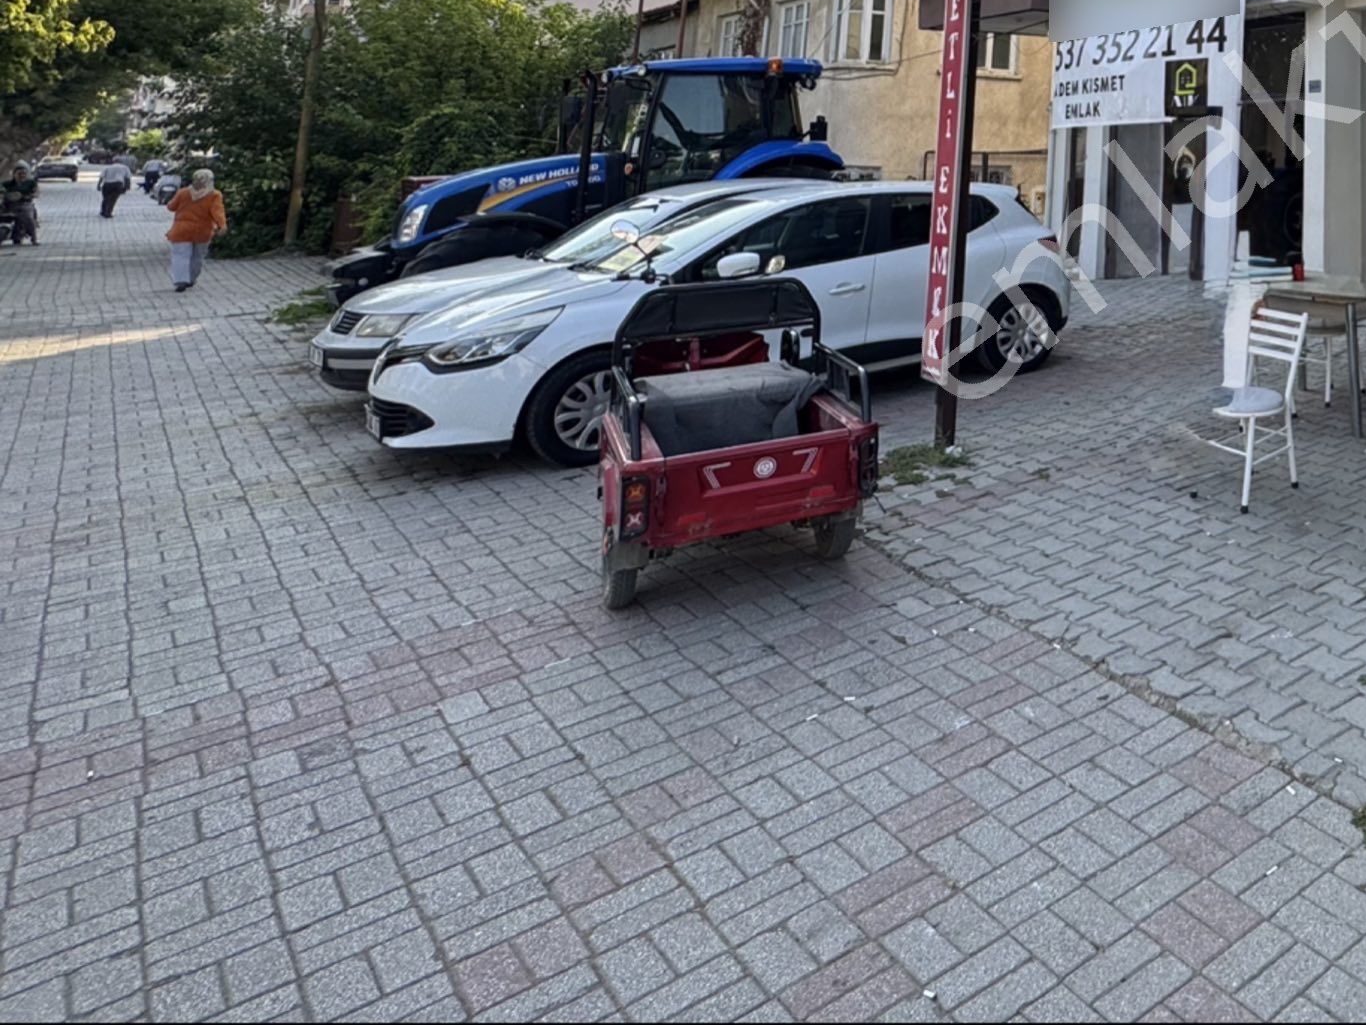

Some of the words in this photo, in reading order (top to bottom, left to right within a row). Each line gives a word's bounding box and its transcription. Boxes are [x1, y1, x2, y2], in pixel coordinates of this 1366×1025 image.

[1092, 29, 1141, 67] 352
[1143, 24, 1176, 59] 21
[1186, 15, 1228, 54] 44
[1082, 75, 1126, 95] KISMET
[1065, 101, 1101, 120] EMLAK
[519, 172, 548, 185] NEW
[925, 164, 949, 360] EKMEK
